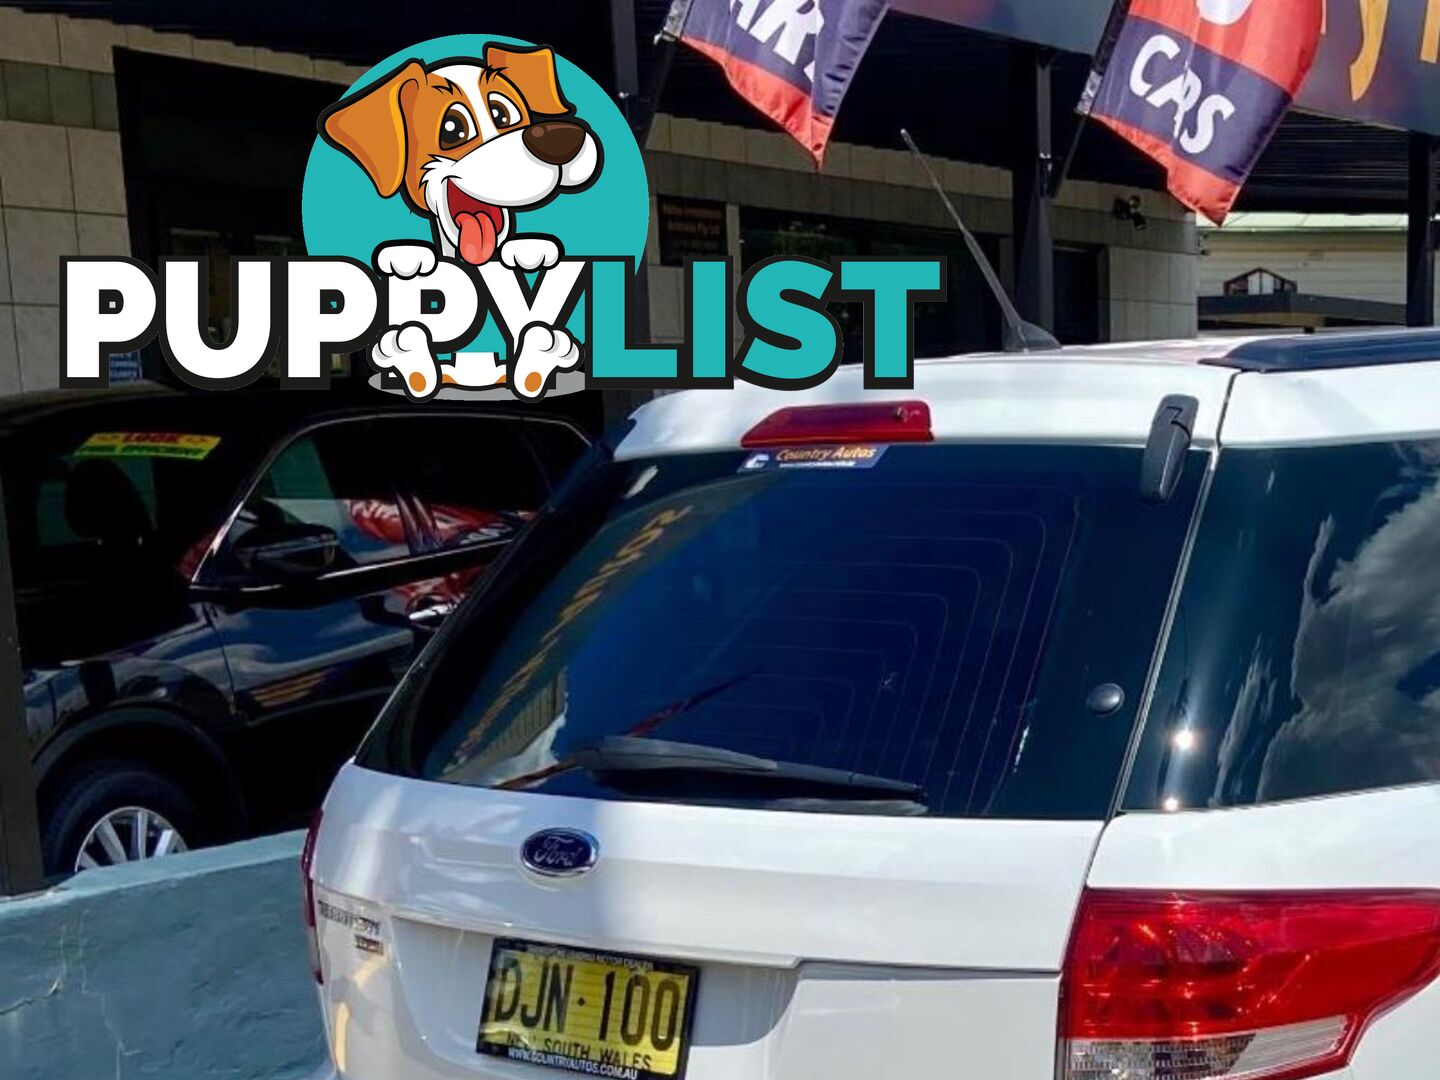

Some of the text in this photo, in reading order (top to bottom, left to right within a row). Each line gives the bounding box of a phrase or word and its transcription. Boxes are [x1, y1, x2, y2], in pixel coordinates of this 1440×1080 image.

[776, 446, 876, 461] Country Autos
[495, 954, 680, 1051] DJN 100
[544, 1038, 591, 1058] SOUTH
[601, 1046, 652, 1070] WALES
